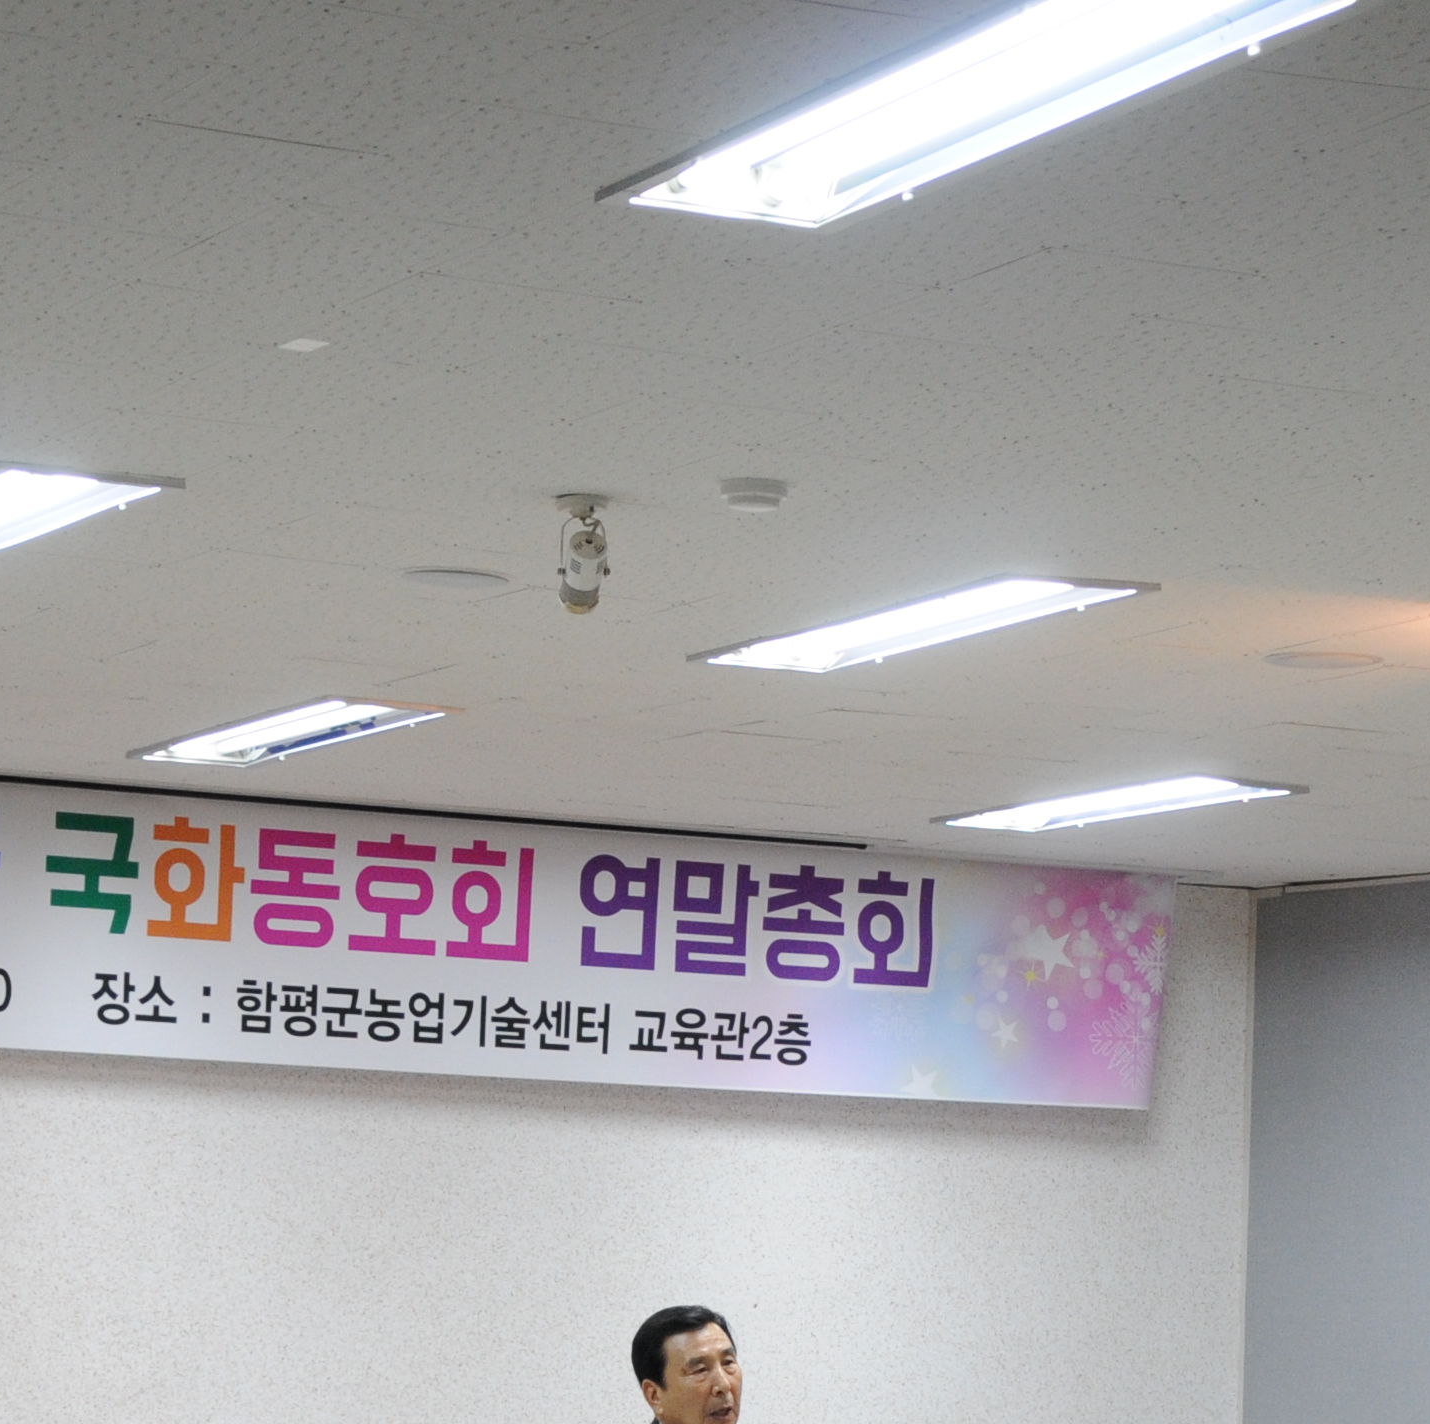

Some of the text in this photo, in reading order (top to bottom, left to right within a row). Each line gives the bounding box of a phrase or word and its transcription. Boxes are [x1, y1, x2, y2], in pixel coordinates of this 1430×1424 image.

[45, 810, 535, 963] 국화동호회
[578, 852, 936, 988] 연말총회
[91, 970, 177, 1026] 장소
[235, 978, 612, 1056] 함평군농업기술센터
[628, 1007, 812, 1067] 교육관2층
